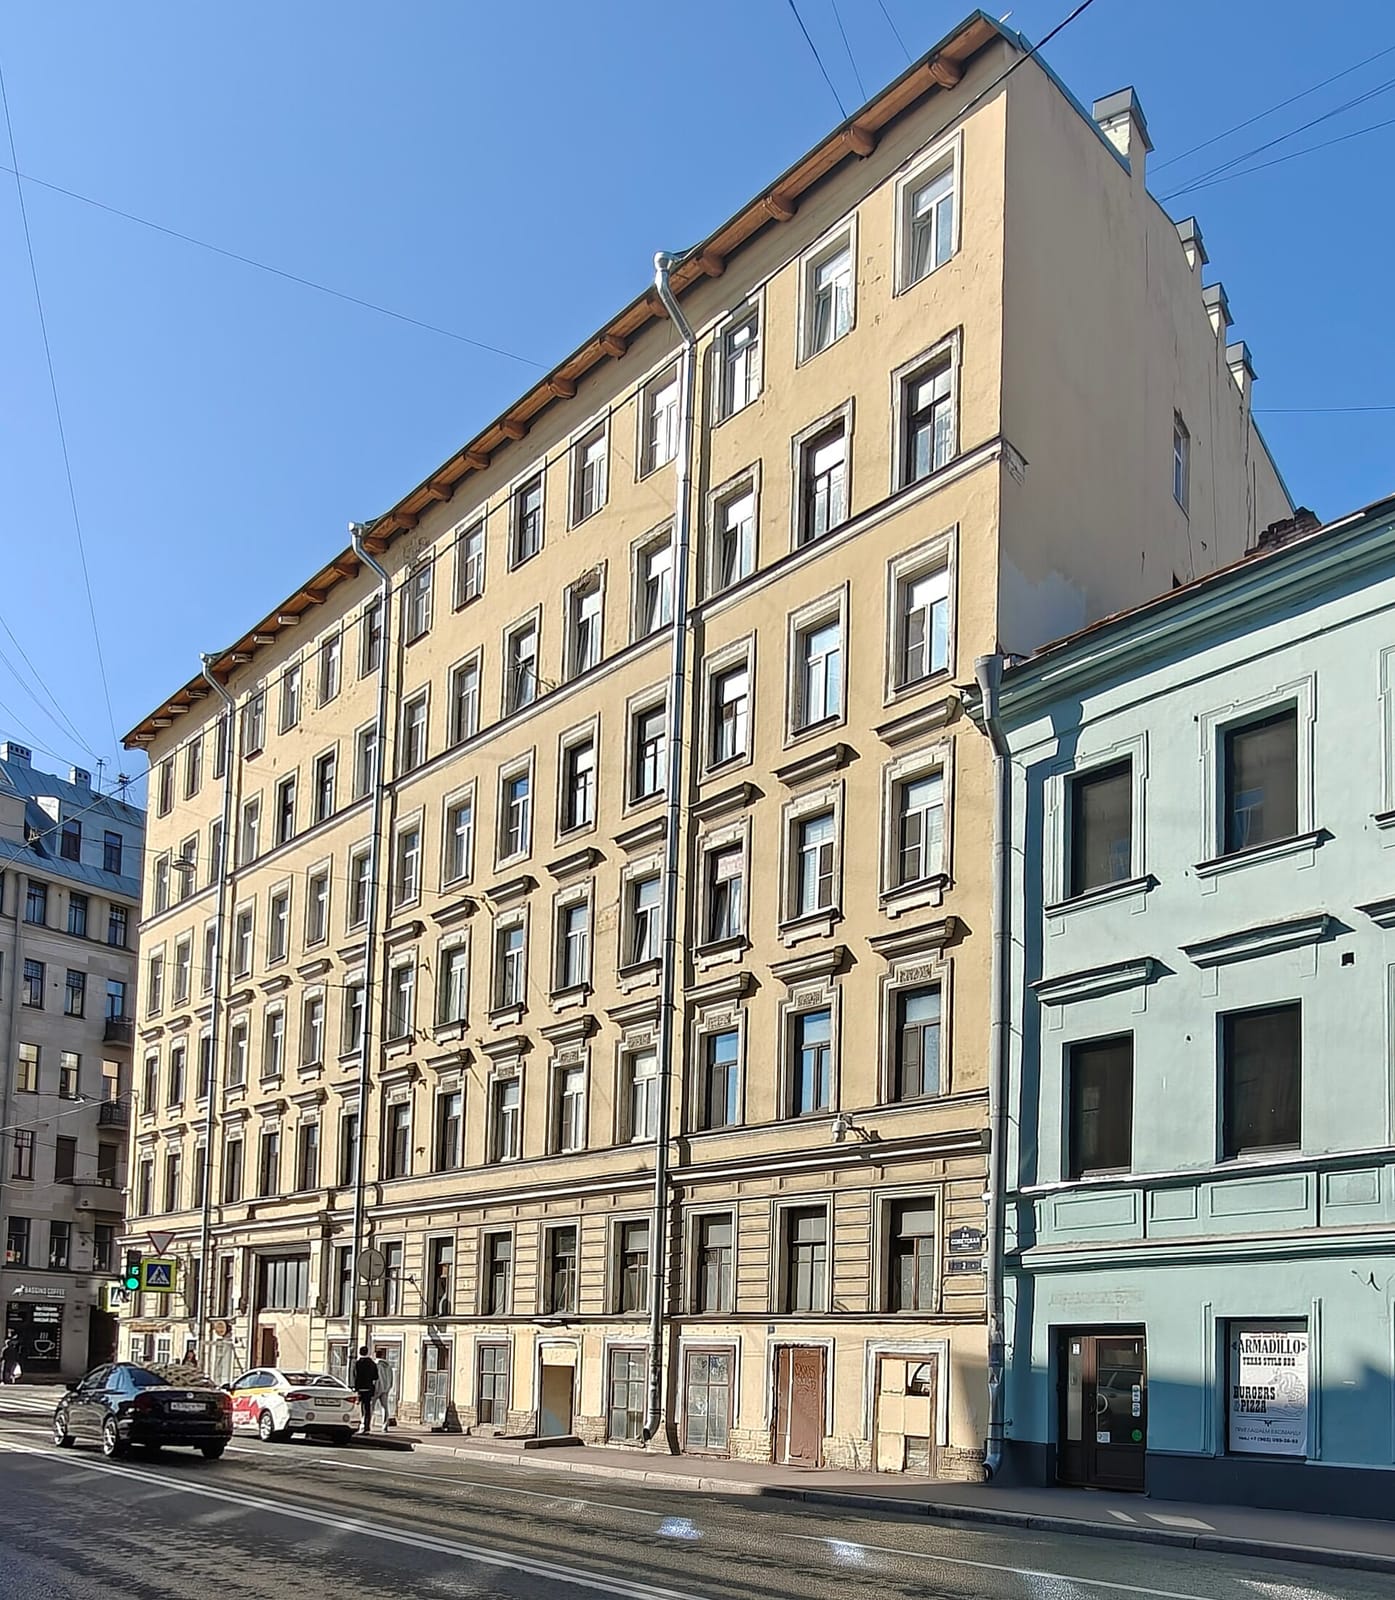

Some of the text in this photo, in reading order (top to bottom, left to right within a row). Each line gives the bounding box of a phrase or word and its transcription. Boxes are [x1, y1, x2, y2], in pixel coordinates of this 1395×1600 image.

[1239, 1339, 1301, 1354] ARMADILLO
[1243, 1357, 1262, 1366] TEXAS
[1263, 1356, 1282, 1366] STYLE
[1233, 1386, 1275, 1400] BURGERS
[1240, 1399, 1267, 1413] PIZZA
